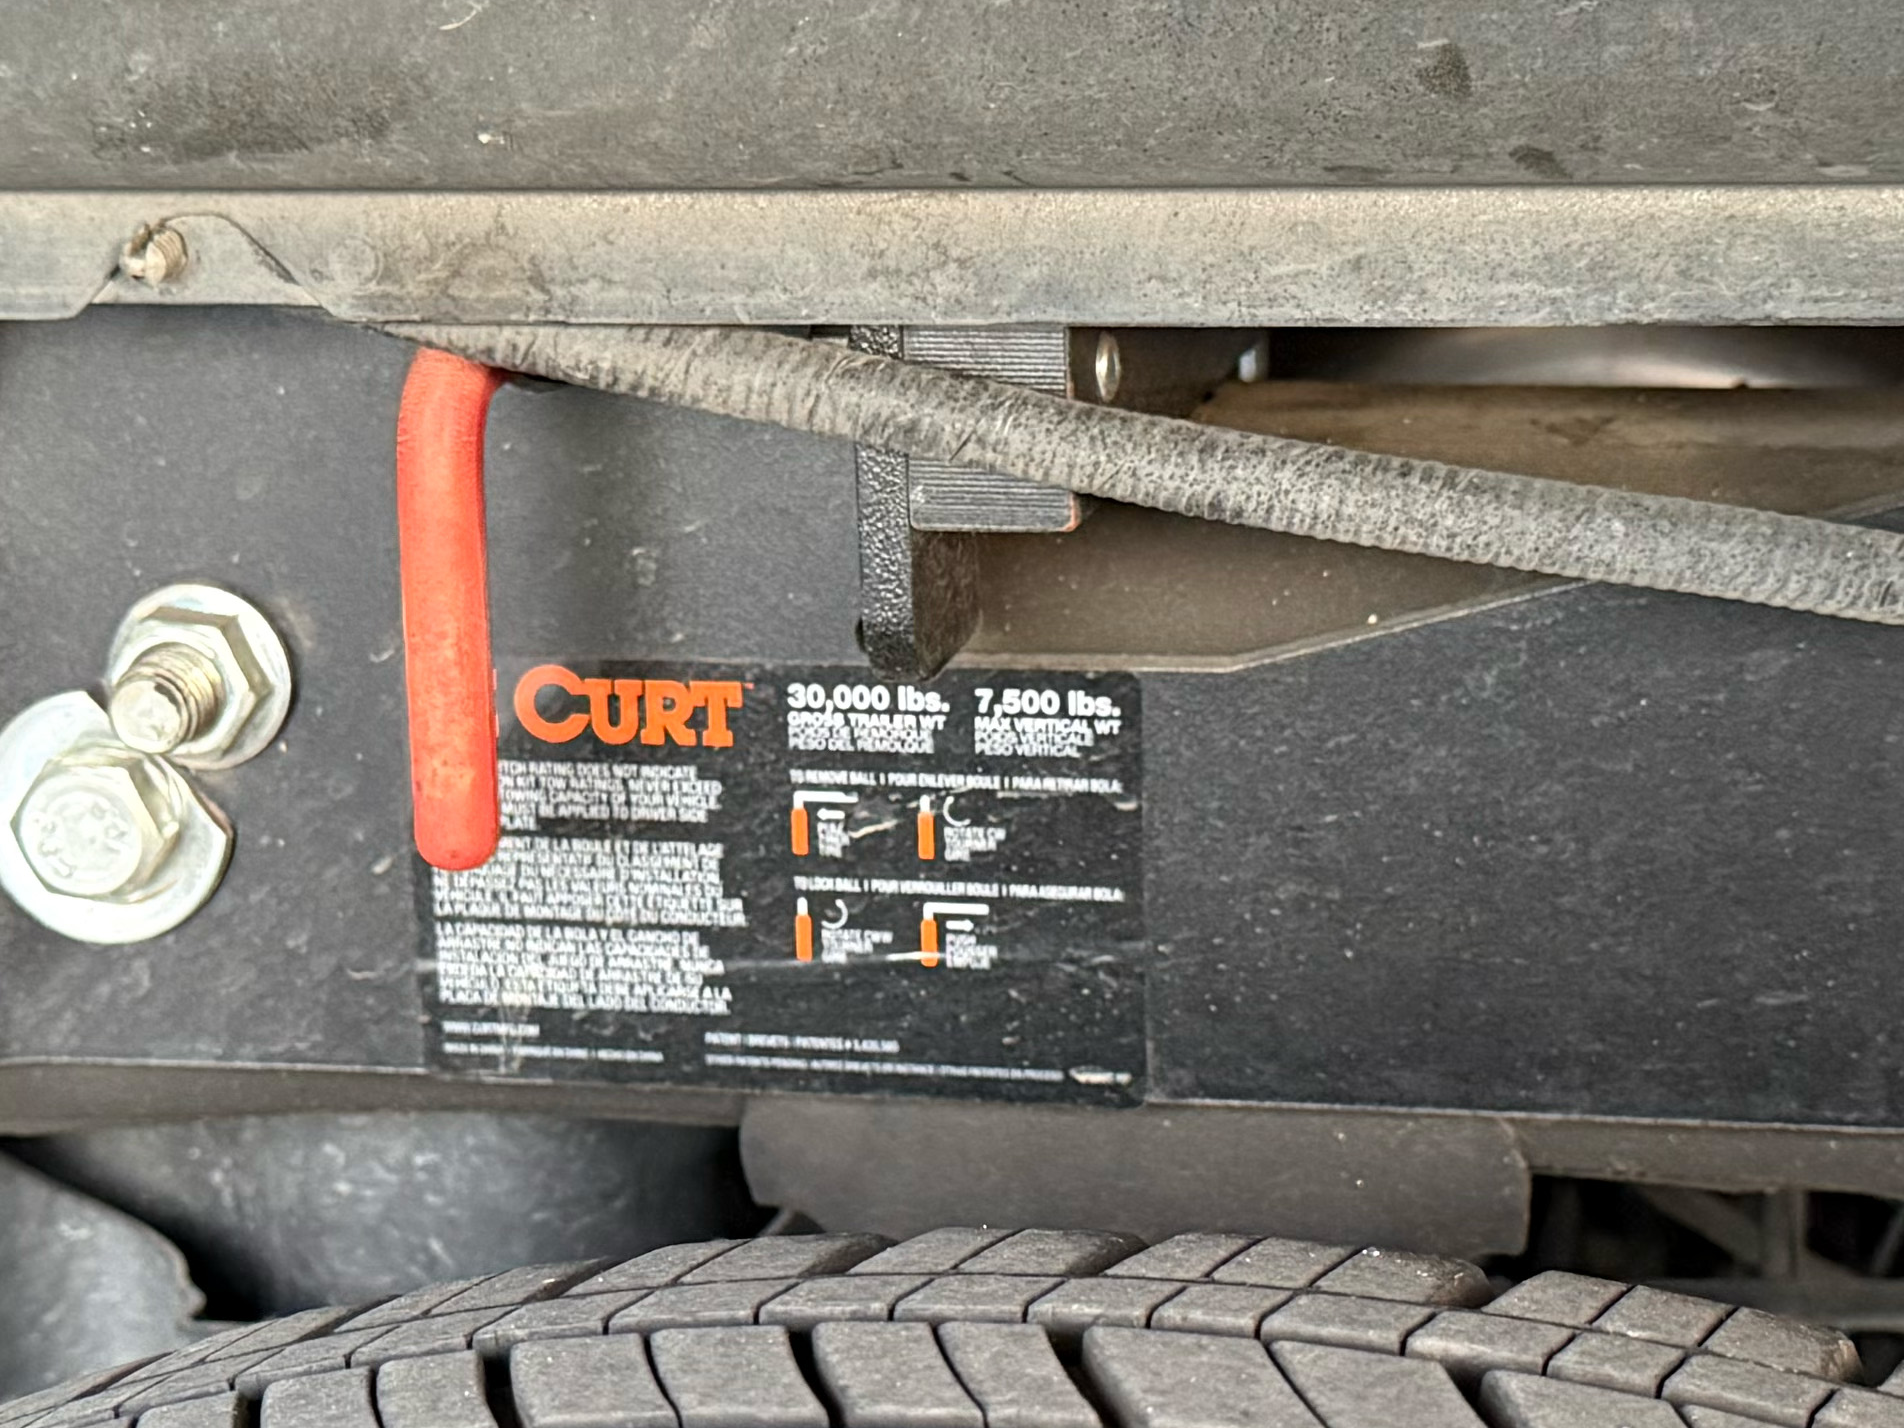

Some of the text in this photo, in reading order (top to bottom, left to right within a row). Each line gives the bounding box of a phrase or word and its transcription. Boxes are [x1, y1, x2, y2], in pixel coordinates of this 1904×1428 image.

[514, 664, 743, 747] CURT
[787, 682, 950, 714] 30,000 lbs.
[974, 688, 1121, 718] 7,500 lbs.
[787, 711, 946, 730] GROSS TRAILER WT
[1013, 718, 1088, 734] VERTICAL
[1094, 719, 1121, 735] WT
[612, 763, 637, 778] NOT
